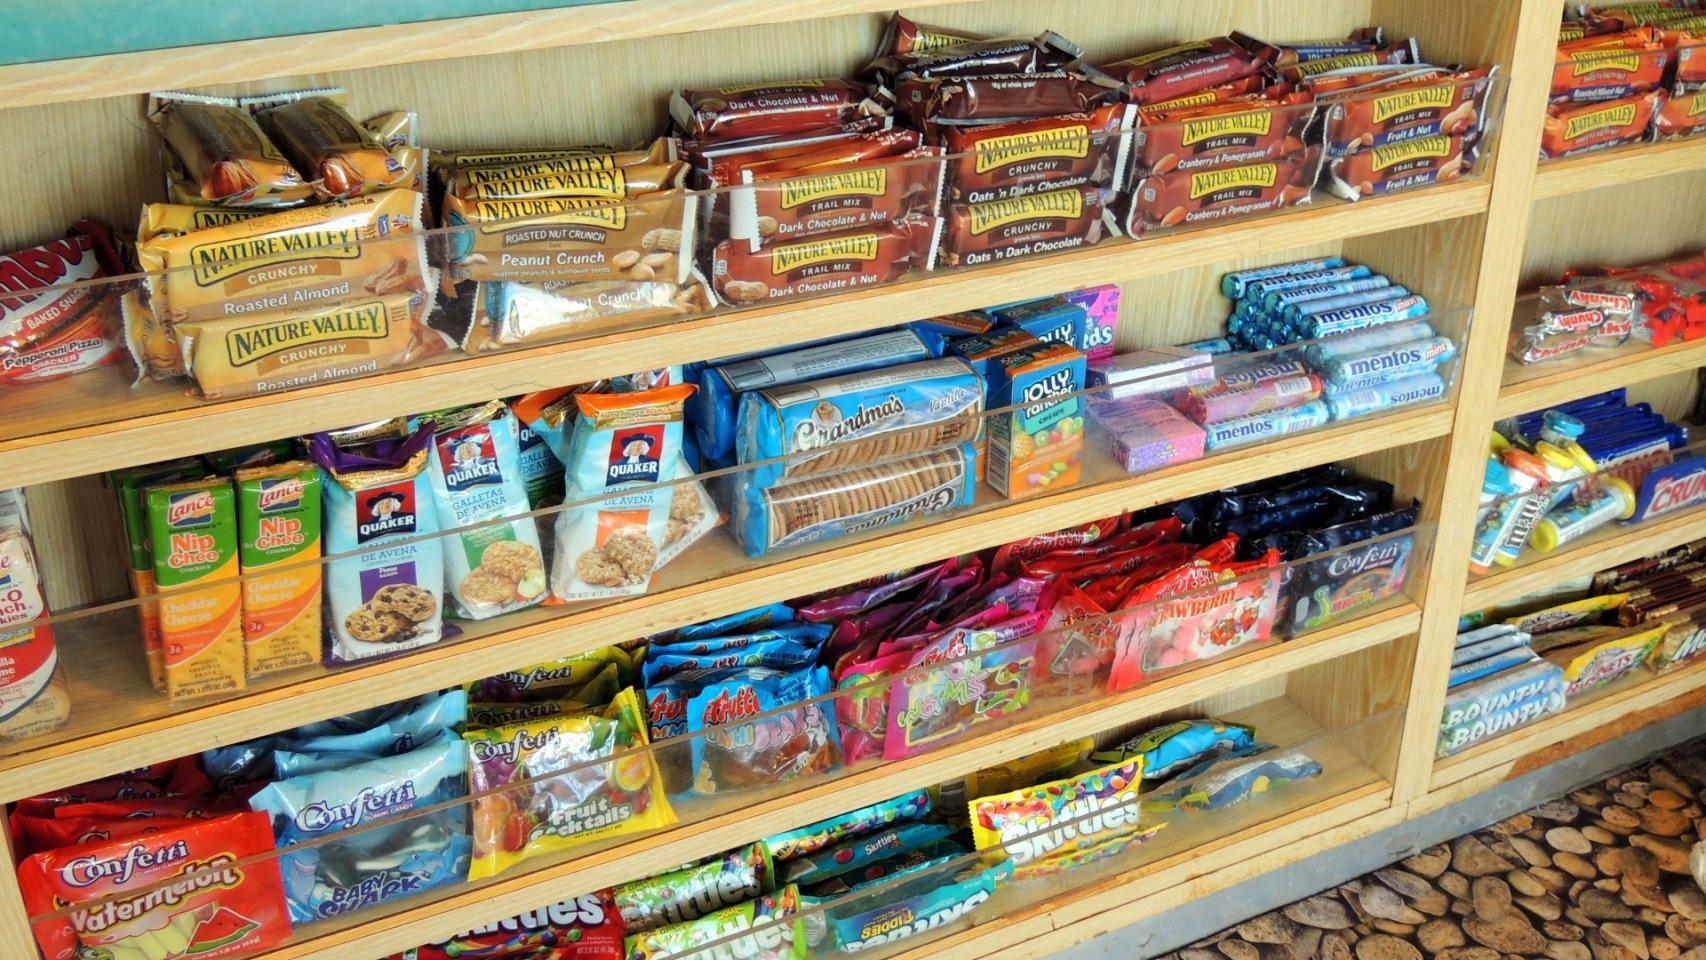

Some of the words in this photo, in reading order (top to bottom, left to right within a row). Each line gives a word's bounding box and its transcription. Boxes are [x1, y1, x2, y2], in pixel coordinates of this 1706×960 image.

[729, 100, 755, 110] Dark
[758, 96, 807, 107] Chocolate
[811, 95, 819, 103] &
[820, 93, 838, 102] Nut
[1377, 94, 1417, 116] NATURE
[1417, 87, 1453, 104] VALLEY
[1187, 121, 1230, 143] NATURE
[1231, 113, 1268, 131] VALLEY
[1394, 114, 1415, 124] TRAIL
[1571, 112, 1603, 135] NATURE
[1603, 106, 1634, 123] VALLEY
[1206, 139, 1229, 149] TRAIL
[1232, 137, 1247, 145] MIX
[1387, 130, 1408, 142] Fruit
[1408, 129, 1414, 138] &
[1416, 125, 1431, 135] Nut
[980, 136, 1035, 168] NATURE
[1036, 128, 1085, 156] VALLEY
[1178, 157, 1212, 169] Cranberry
[1213, 156, 1220, 164] &
[1221, 149, 1266, 164] Pomegranate
[1375, 145, 1418, 168] NATURE
[1418, 136, 1449, 154] VALLEY
[476, 162, 545, 183] NATURE
[545, 155, 606, 173] VALLEY
[1008, 161, 1058, 176] CRUNCHY
[1393, 163, 1414, 172] TRAIL
[1417, 160, 1431, 168] MIX
[484, 176, 555, 200] NATURE
[556, 170, 617, 194] VALLEY
[786, 177, 837, 205] NATURE
[838, 169, 883, 192] VALLEY
[969, 191, 994, 203] Oats
[1038, 176, 1087, 192] Chocolate
[1194, 174, 1237, 195] NATURE
[1237, 166, 1274, 184] VALLEY
[1386, 178, 1407, 190] Fruit
[1415, 174, 1430, 183] Nut
[811, 201, 839, 212] TRAIL
[843, 198, 862, 207] MIX
[1213, 191, 1236, 201] TRAIL
[1238, 189, 1254, 197] MIX
[779, 222, 803, 234] Dark
[807, 214, 856, 231] Chocolate
[859, 213, 867, 222] &
[870, 210, 887, 221] Nut
[975, 199, 1029, 229] NATURE
[1030, 192, 1079, 217] VALLEY
[1185, 210, 1220, 222] Cranberry
[1220, 208, 1227, 216] &
[1228, 201, 1271, 217] Pomegranate
[505, 230, 547, 244] ROASTED
[549, 229, 567, 239] NUT
[569, 229, 606, 242] CRUNCH
[1003, 222, 1052, 237] CRUNCHY
[198, 233, 281, 280] NATURE
[284, 229, 350, 258] VALLEY
[501, 253, 551, 266] Peanut
[557, 251, 605, 265] Crunch
[776, 243, 828, 270] NATURE
[828, 236, 874, 258] VALLEY
[967, 252, 991, 265] Oats
[1006, 245, 1032, 258] Dark
[1033, 236, 1082, 254] Chocolate
[247, 262, 318, 286] CRUNCHY
[801, 265, 829, 276] TRAIL
[833, 263, 851, 271] MIX
[770, 286, 794, 298] Dark
[798, 279, 846, 295] Chocolate
[850, 277, 857, 286] &
[860, 274, 877, 285] Nut
[1283, 284, 1337, 299] mentos
[223, 293, 288, 315] Roasted
[293, 282, 350, 303] Almond
[1320, 302, 1393, 325] mentos
[1398, 296, 1417, 312] mint
[26, 306, 61, 330] BAKED
[234, 319, 311, 359] NATURE
[312, 306, 381, 336] VALLEY
[4, 343, 69, 370] Pepperoni
[69, 338, 101, 351] Pizza
[31, 354, 78, 371] CRACKER
[279, 343, 347, 365] CRUNCHY
[1350, 349, 1422, 376] mentos
[1425, 342, 1447, 360] mint
[256, 371, 318, 394] Roasted
[322, 359, 377, 379] Almond
[1226, 360, 1298, 385] mentos
[1023, 367, 1070, 405] JOLLY
[1390, 385, 1441, 404] mentos
[792, 395, 904, 450] Grandma's
[928, 387, 967, 413] Vanilla
[1215, 419, 1273, 441] mentos
[447, 461, 498, 486] QUAKER
[609, 460, 658, 478] QUAKER
[259, 480, 304, 508] Lance
[452, 487, 504, 511] GALLETAS
[619, 495, 655, 505] AVENA
[168, 494, 215, 523] Lance
[456, 510, 472, 520] DE
[472, 496, 507, 514] AVENA
[260, 517, 301, 537] Nip
[360, 514, 414, 535] QUAKER
[171, 531, 215, 553] Nip
[256, 532, 304, 550] Chee
[169, 550, 219, 568] Chee
[361, 553, 377, 562] DE
[379, 545, 418, 559] AVENA
[1328, 542, 1399, 578] Confetti
[247, 578, 300, 593] Cheddar
[164, 597, 217, 614] Cheddar
[1446, 679, 1545, 730] BOUNTY
[1451, 695, 1549, 750] BOUNTY
[470, 726, 561, 764] Confetti
[296, 780, 418, 832] Confetti
[390, 803, 414, 816] CANDY
[1000, 791, 1140, 866] Skittles
[864, 832, 898, 856] Skittles
[61, 840, 189, 887] Confetti
[318, 876, 421, 918] SHARK
[331, 871, 387, 901] BABY
